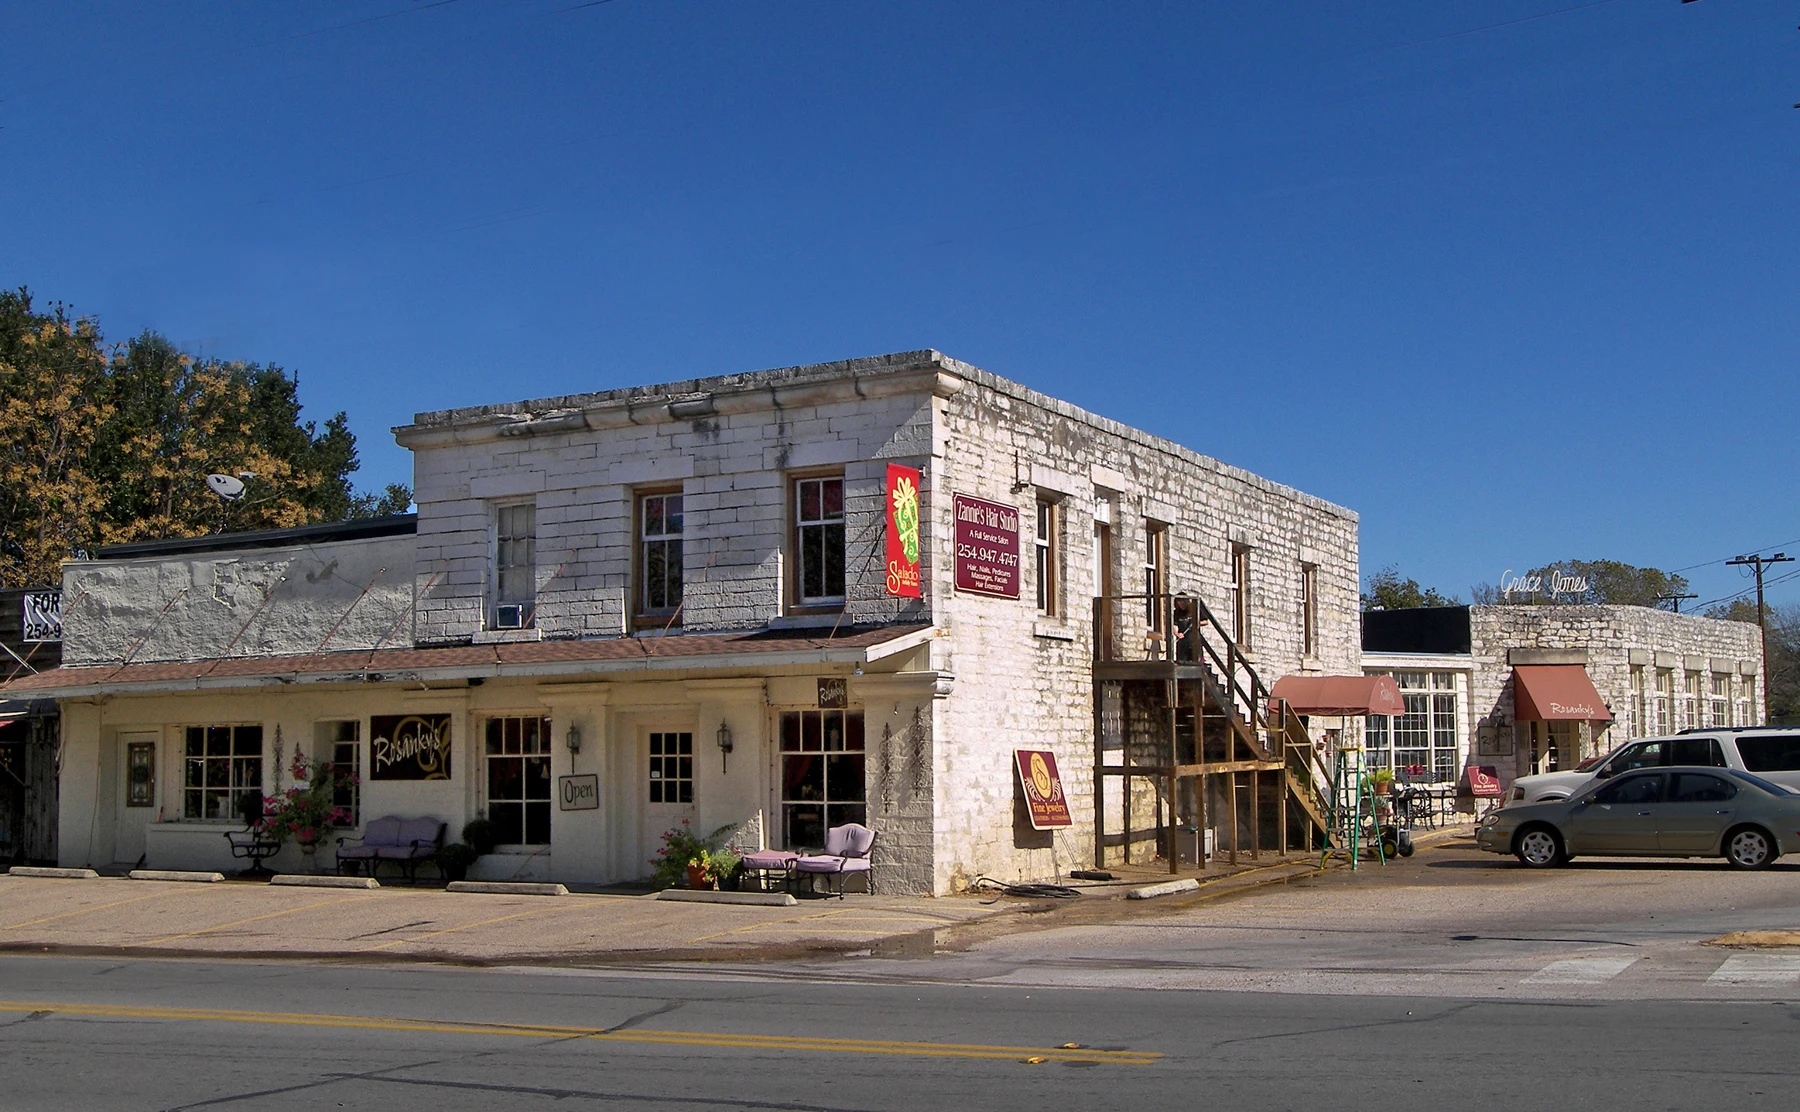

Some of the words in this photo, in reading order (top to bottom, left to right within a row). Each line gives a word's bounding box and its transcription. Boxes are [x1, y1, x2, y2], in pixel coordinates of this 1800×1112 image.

[957, 500, 985, 525] Zannie's
[985, 507, 999, 528] Hair
[1000, 510, 1018, 533] Studio
[969, 529, 974, 538] A
[974, 530, 982, 540] Full
[983, 532, 997, 543] Service
[998, 535, 1009, 545] Salon
[957, 543, 1018, 567] 254.947.4747
[886, 559, 919, 594] Salado
[1501, 569, 1542, 599] Grace
[1551, 570, 1588, 599] Jones
[33, 593, 60, 613] FOR
[564, 780, 593, 806] Open
[1033, 802, 1046, 813] Fine
[1046, 801, 1066, 815] Jewelry
